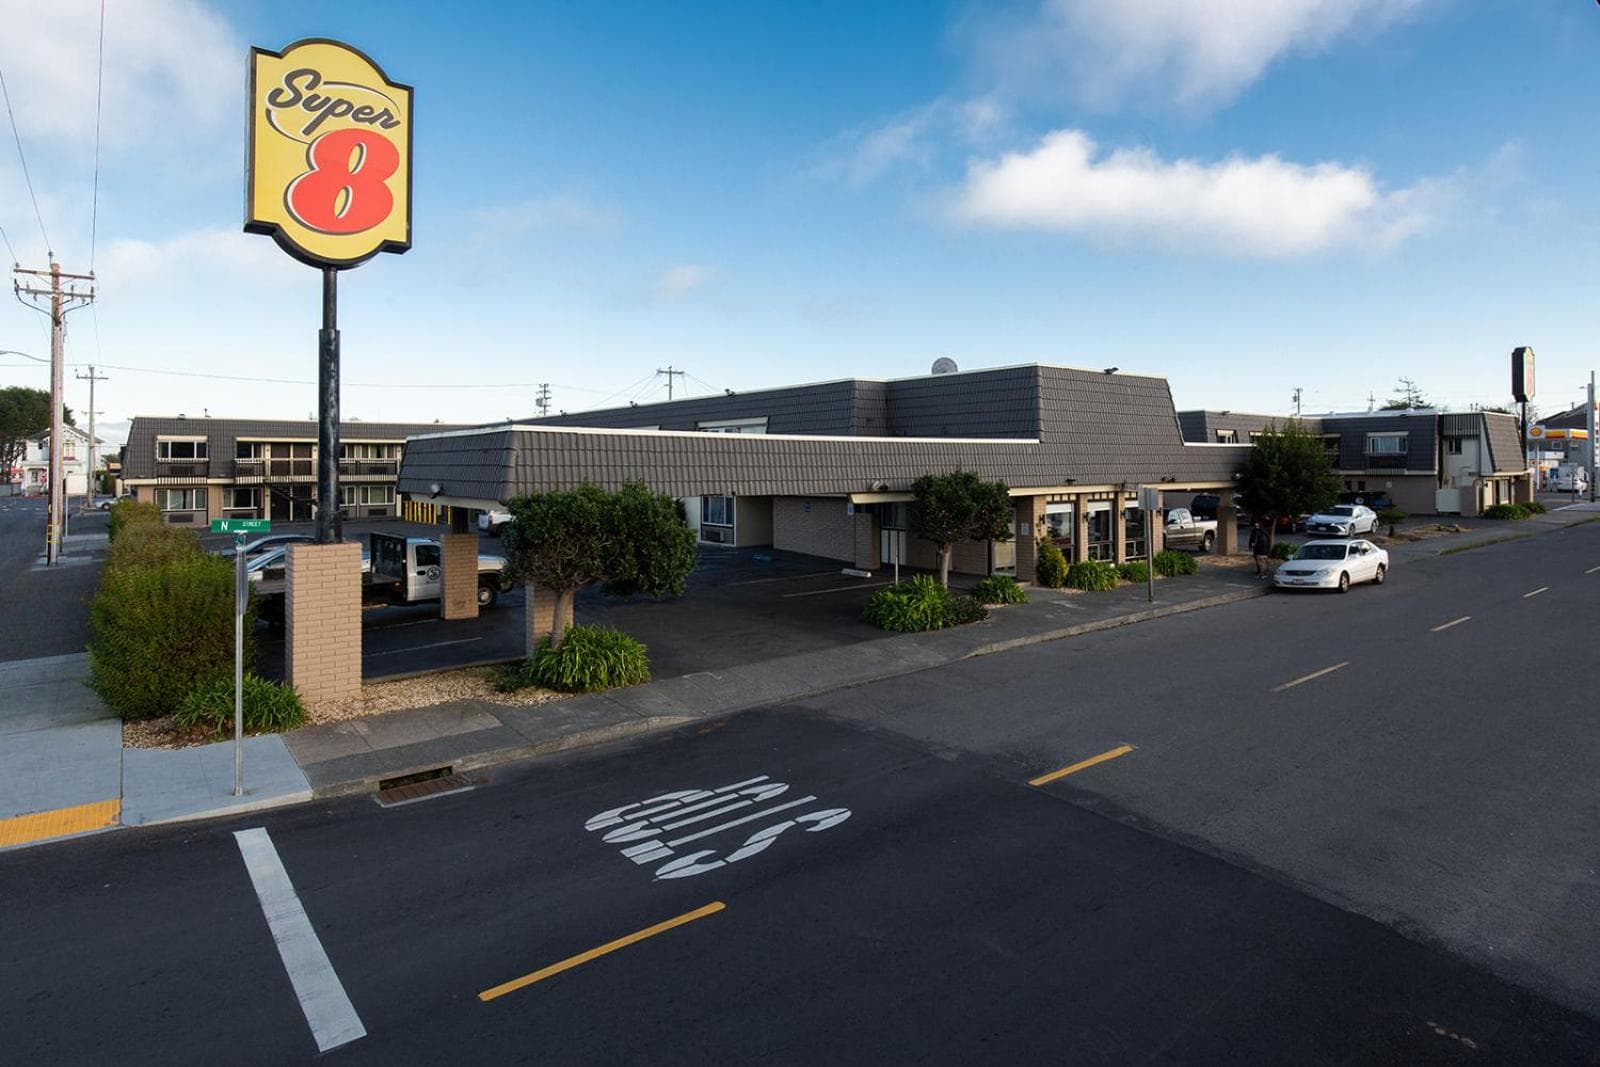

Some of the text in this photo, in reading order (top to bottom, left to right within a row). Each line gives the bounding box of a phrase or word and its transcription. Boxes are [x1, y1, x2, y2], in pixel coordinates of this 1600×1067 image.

[267, 68, 401, 136] Super
[283, 127, 400, 235] 8
[220, 520, 229, 531] N
[584, 775, 851, 881] STOP
